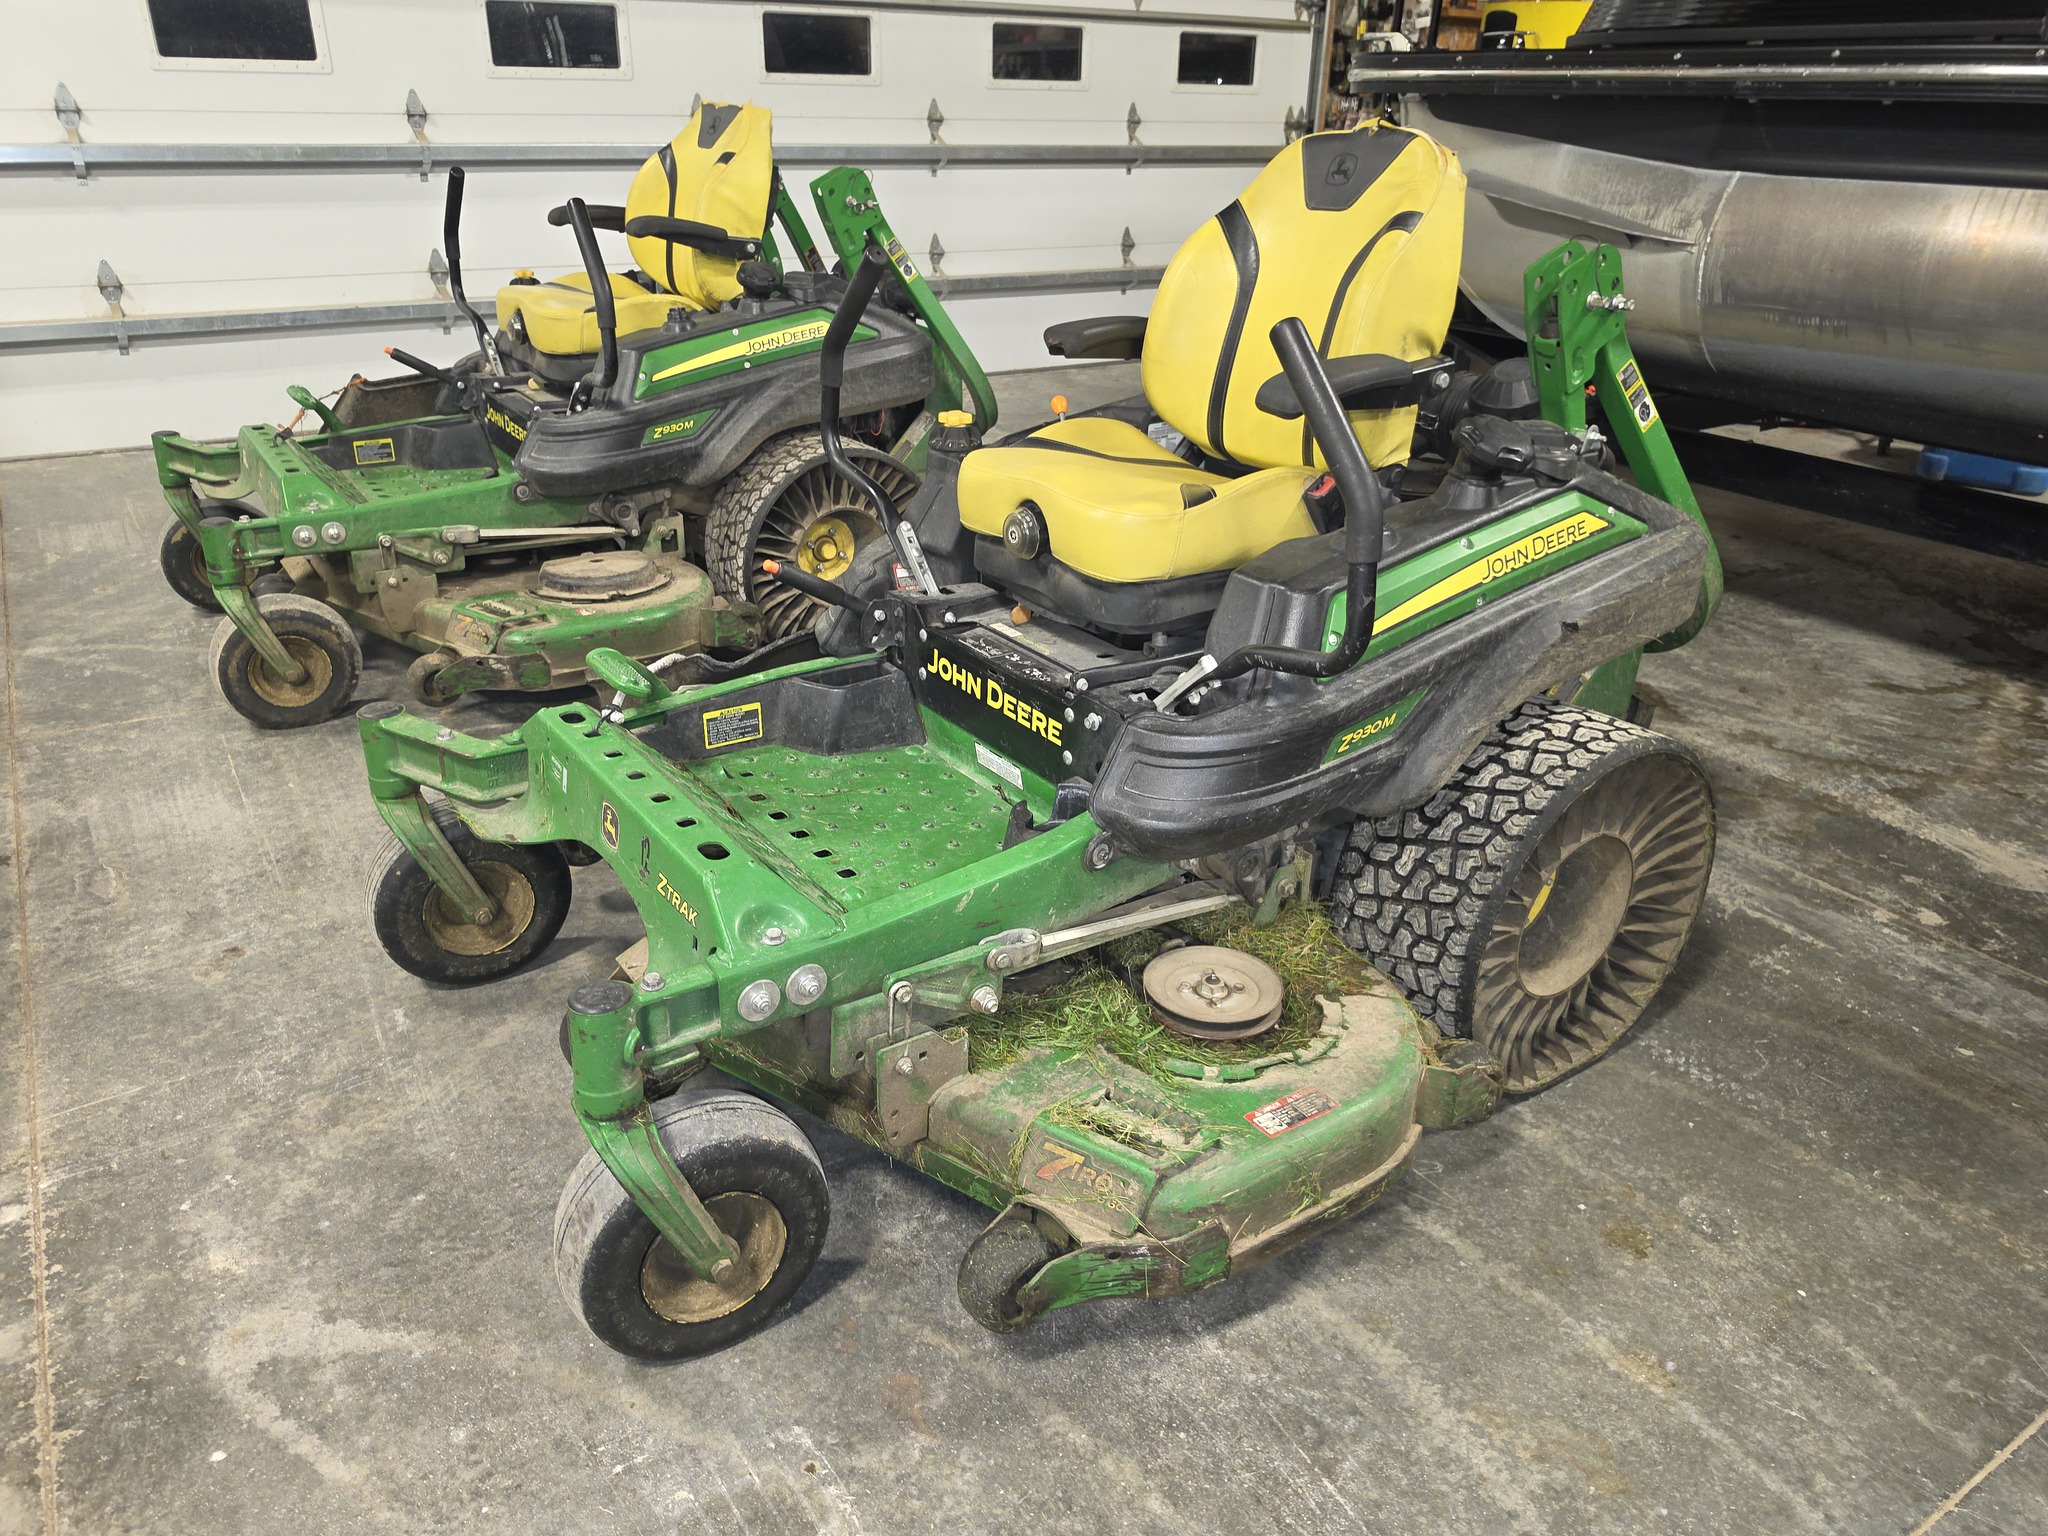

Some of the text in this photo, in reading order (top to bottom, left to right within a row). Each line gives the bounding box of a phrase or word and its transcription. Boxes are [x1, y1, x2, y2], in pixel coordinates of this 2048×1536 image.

[745, 325, 825, 354] JOHN DEERE
[487, 403, 504, 430] JOHN
[653, 420, 694, 439] Z930M
[1482, 520, 1587, 580] JOHN DEERE
[927, 648, 982, 700] JOHN
[986, 678, 1063, 747] DEERE
[1337, 712, 1397, 753] Z930M
[656, 870, 699, 928] ZTRAK
